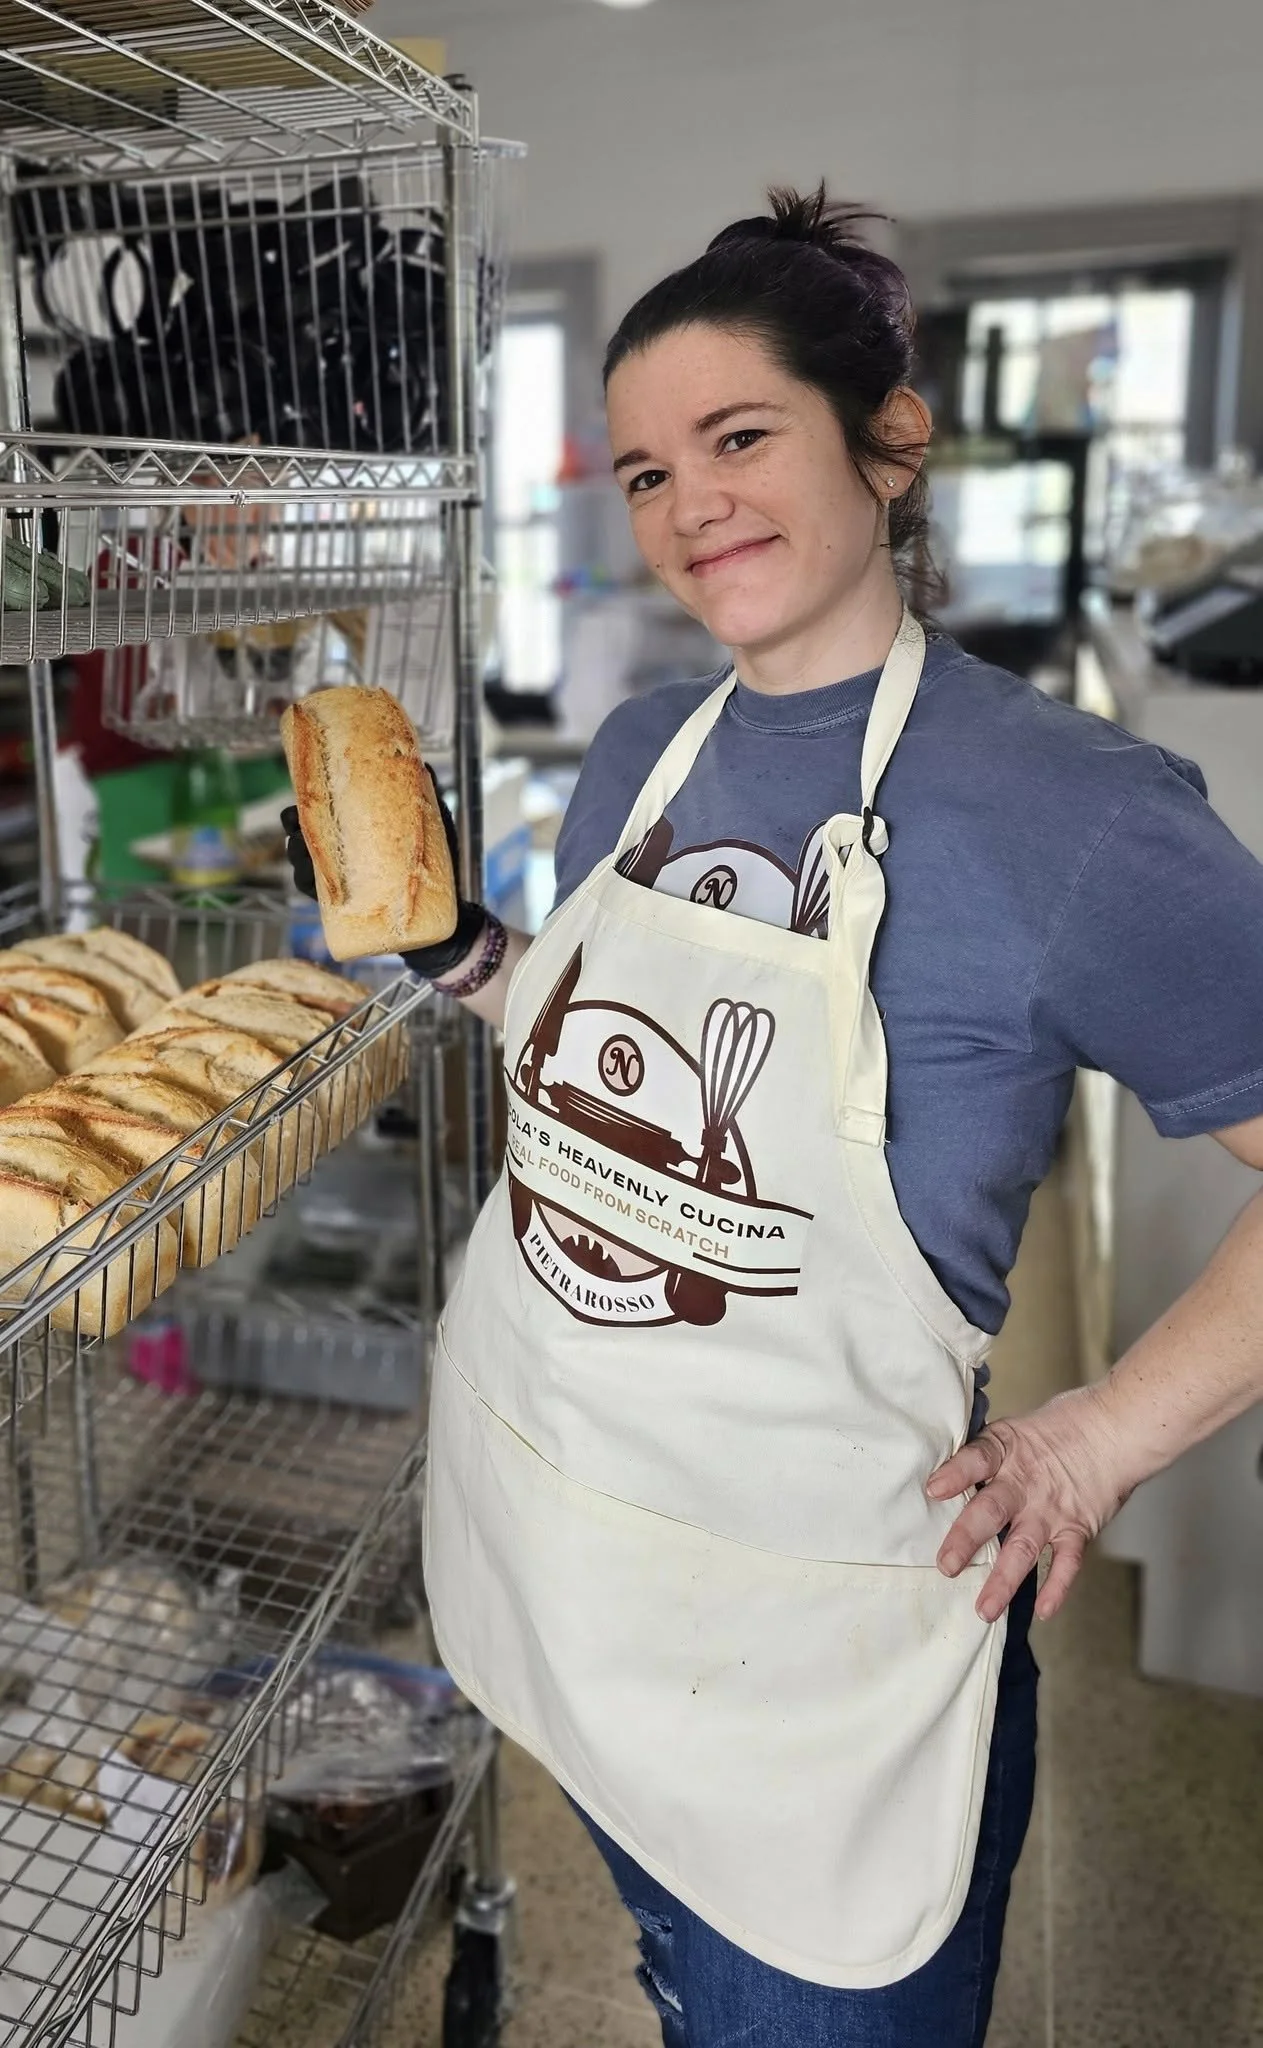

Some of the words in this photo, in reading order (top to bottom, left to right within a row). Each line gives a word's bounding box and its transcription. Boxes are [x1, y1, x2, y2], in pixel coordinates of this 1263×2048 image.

[605, 1046, 641, 1088] N
[538, 1156, 581, 1190] FOOD
[583, 1183, 632, 1217] FROM
[635, 1208, 730, 1259] SCRATCH
[557, 1141, 670, 1207] HEAVENLY
[679, 1202, 787, 1240] CUCINA
[529, 1233, 656, 1313] PIETRAROSSO
